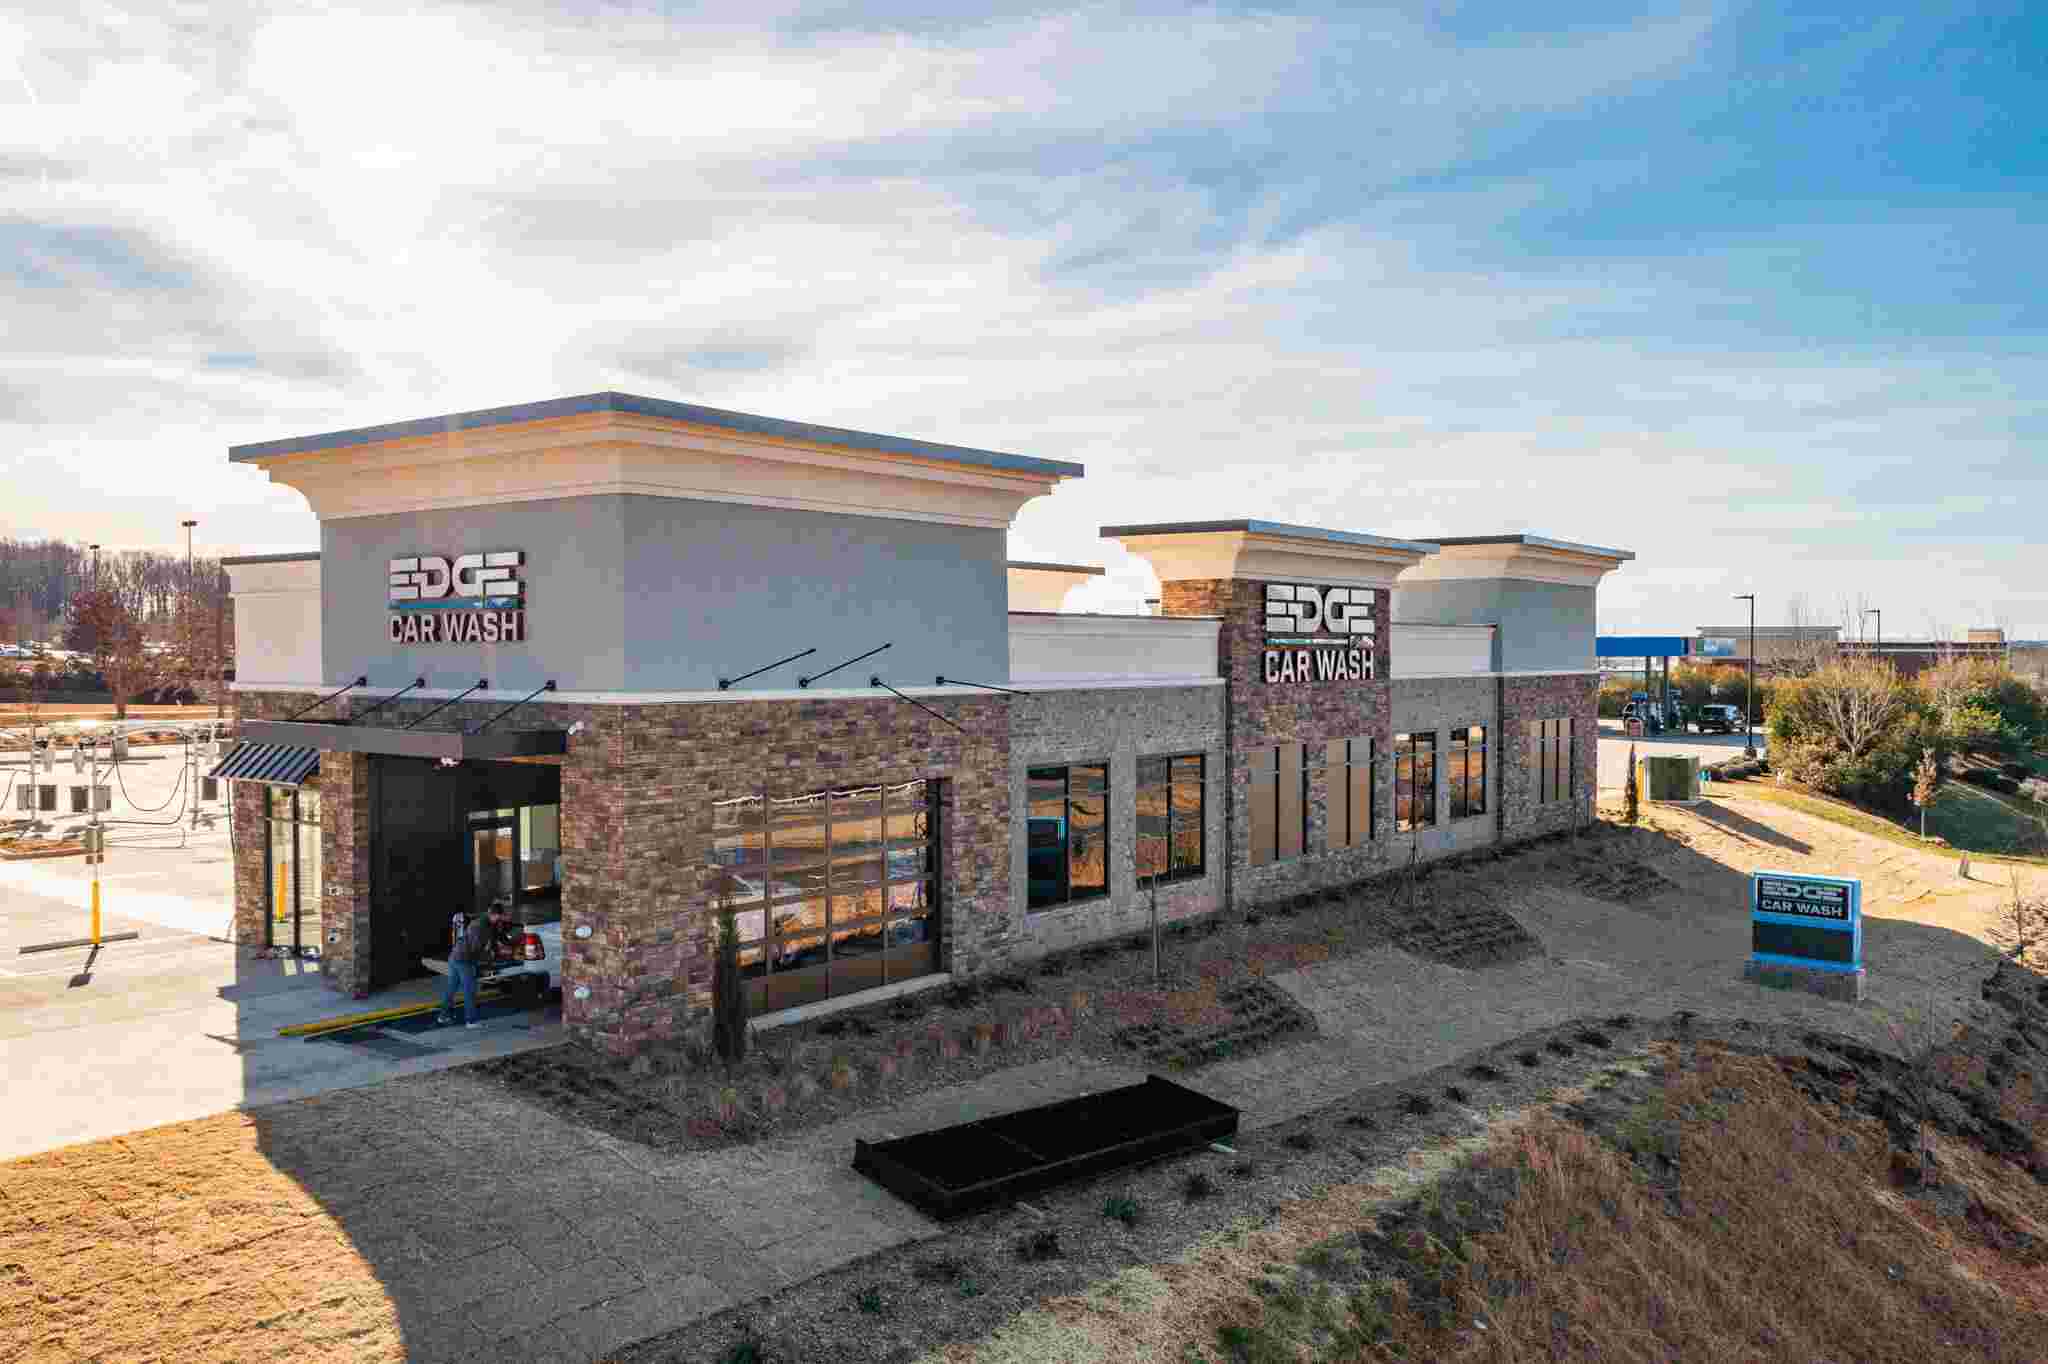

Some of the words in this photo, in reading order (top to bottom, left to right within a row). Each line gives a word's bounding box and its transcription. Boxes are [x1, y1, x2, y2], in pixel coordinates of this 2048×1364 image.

[389, 552, 521, 600] EDGE
[1266, 584, 1375, 633] EDGE
[390, 613, 436, 642] CAR
[441, 611, 520, 641] WASH
[1265, 650, 1312, 683] CAR
[1316, 649, 1375, 681] WASH
[1762, 880, 1843, 902] EDGE
[1762, 900, 1792, 912] CAR
[1794, 902, 1841, 917] WASH
